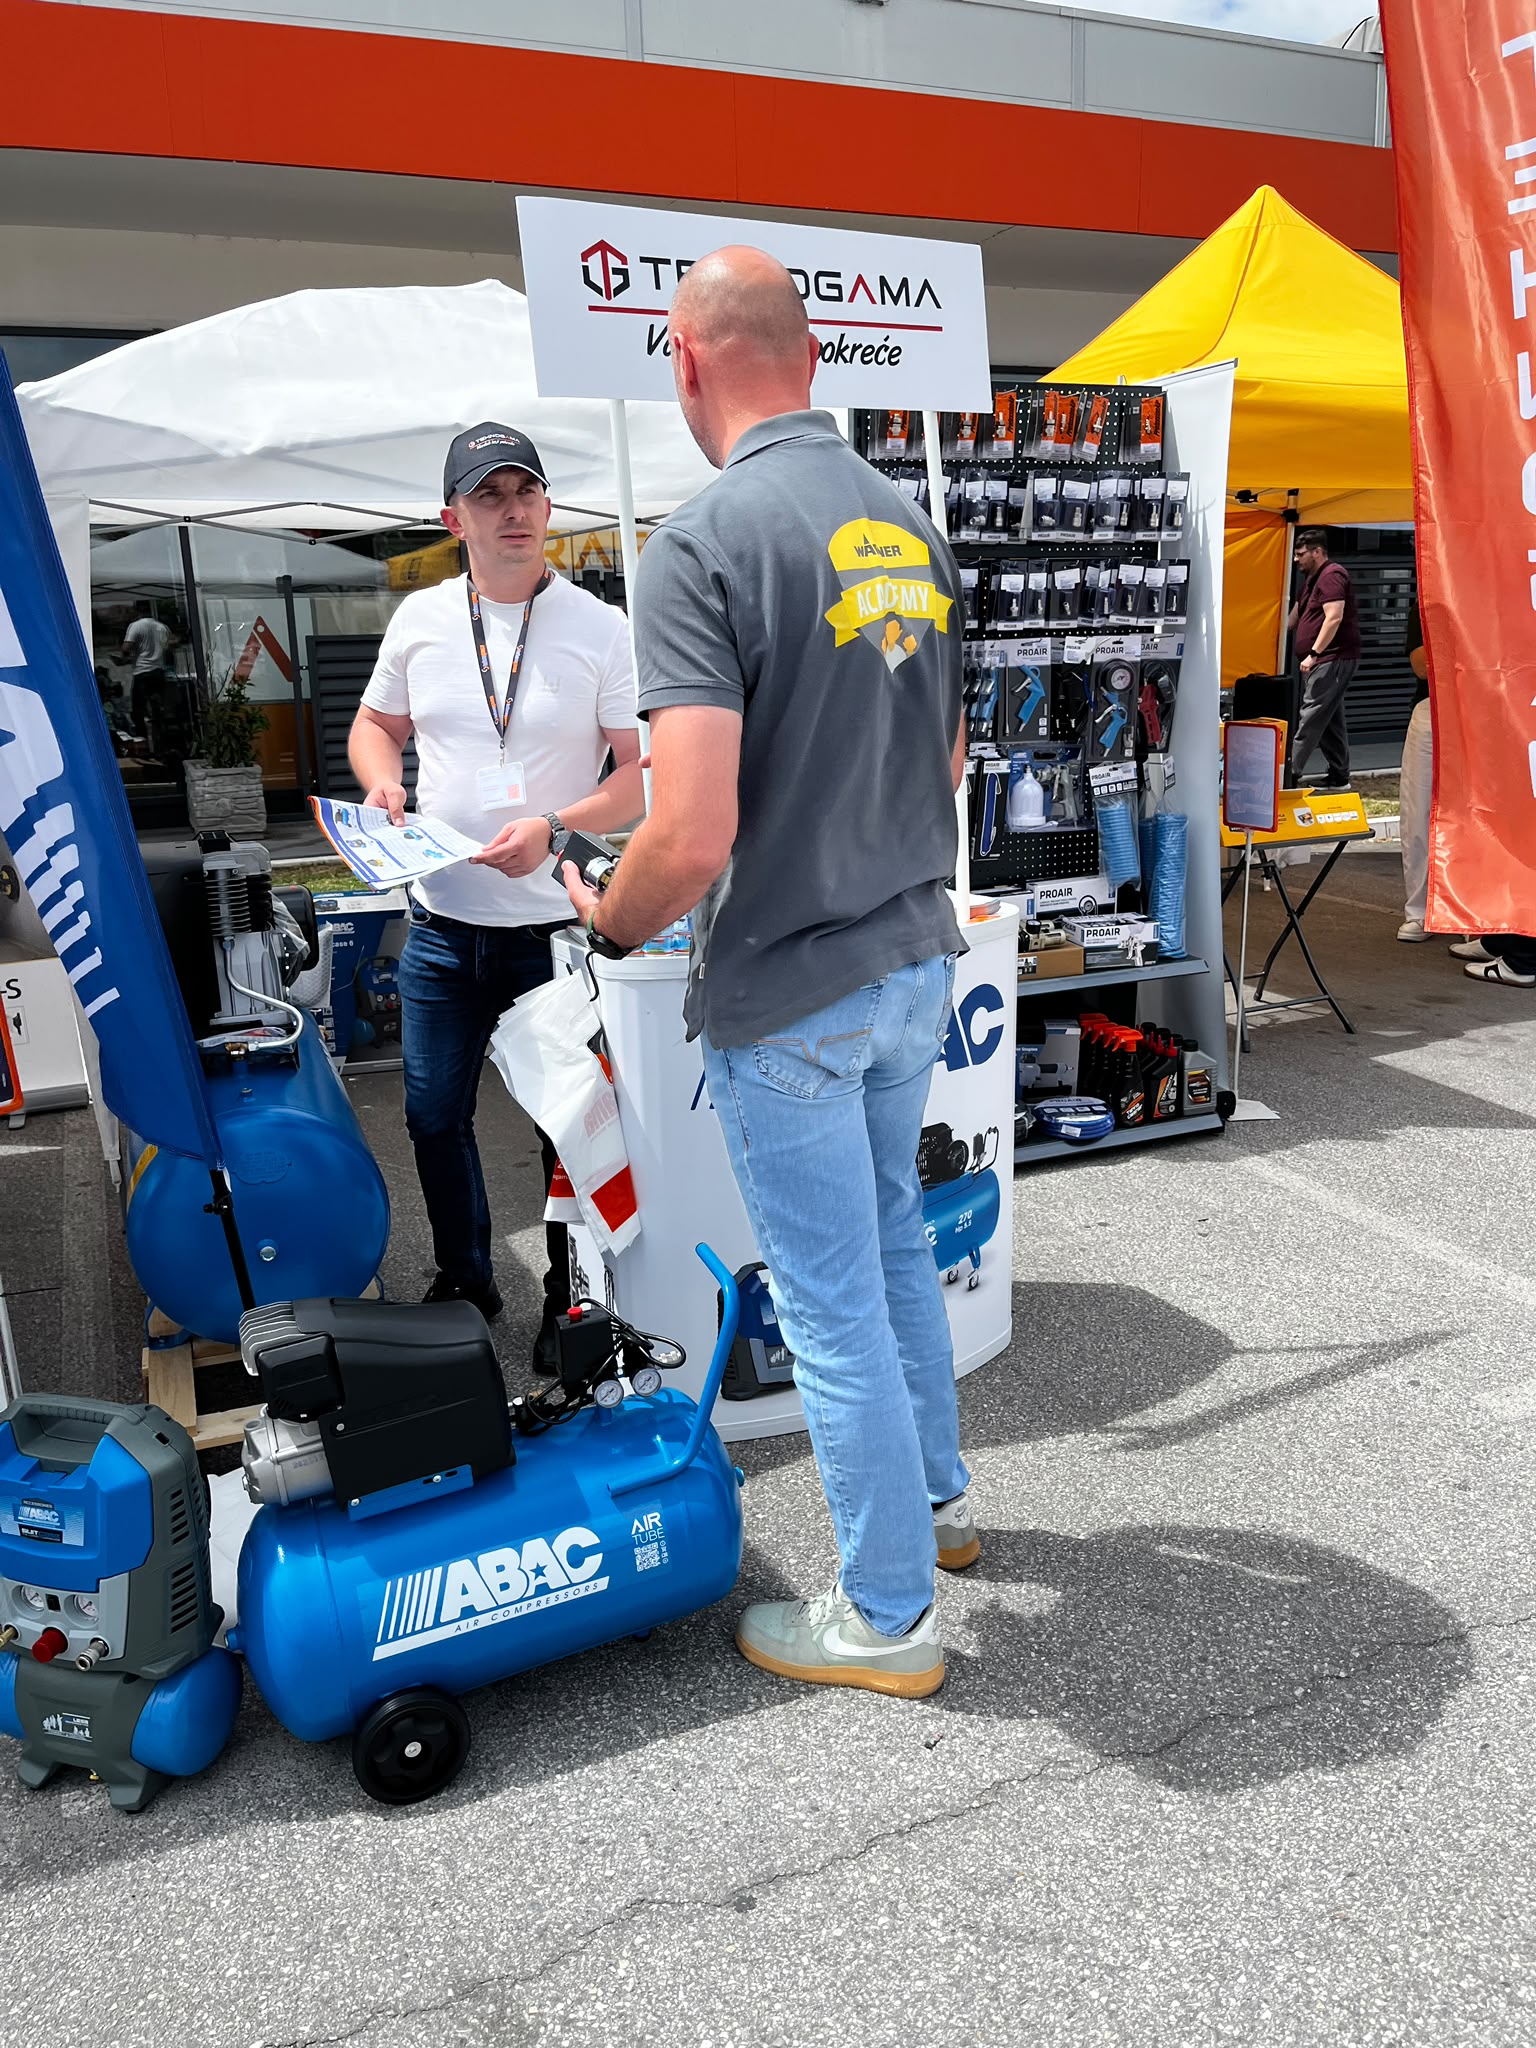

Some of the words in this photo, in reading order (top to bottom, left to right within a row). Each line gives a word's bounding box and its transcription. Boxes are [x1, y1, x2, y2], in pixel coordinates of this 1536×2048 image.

[639, 255, 943, 310] TOGAMA
[816, 332, 903, 367] okreće
[1016, 648, 1048, 657] PROAIR
[1095, 646, 1125, 654] PROAIR
[1039, 887, 1073, 900] PROAIR
[1086, 927, 1121, 938] PROAIR
[957, 1209, 973, 1225] 270
[29, 1507, 60, 1523] ABAC
[631, 1511, 663, 1536] AIR
[631, 1527, 666, 1546] TUBE
[440, 1526, 604, 1624] ABAC
[454, 1618, 480, 1633] AIR
[491, 1582, 600, 1622] COMPRESSORS
